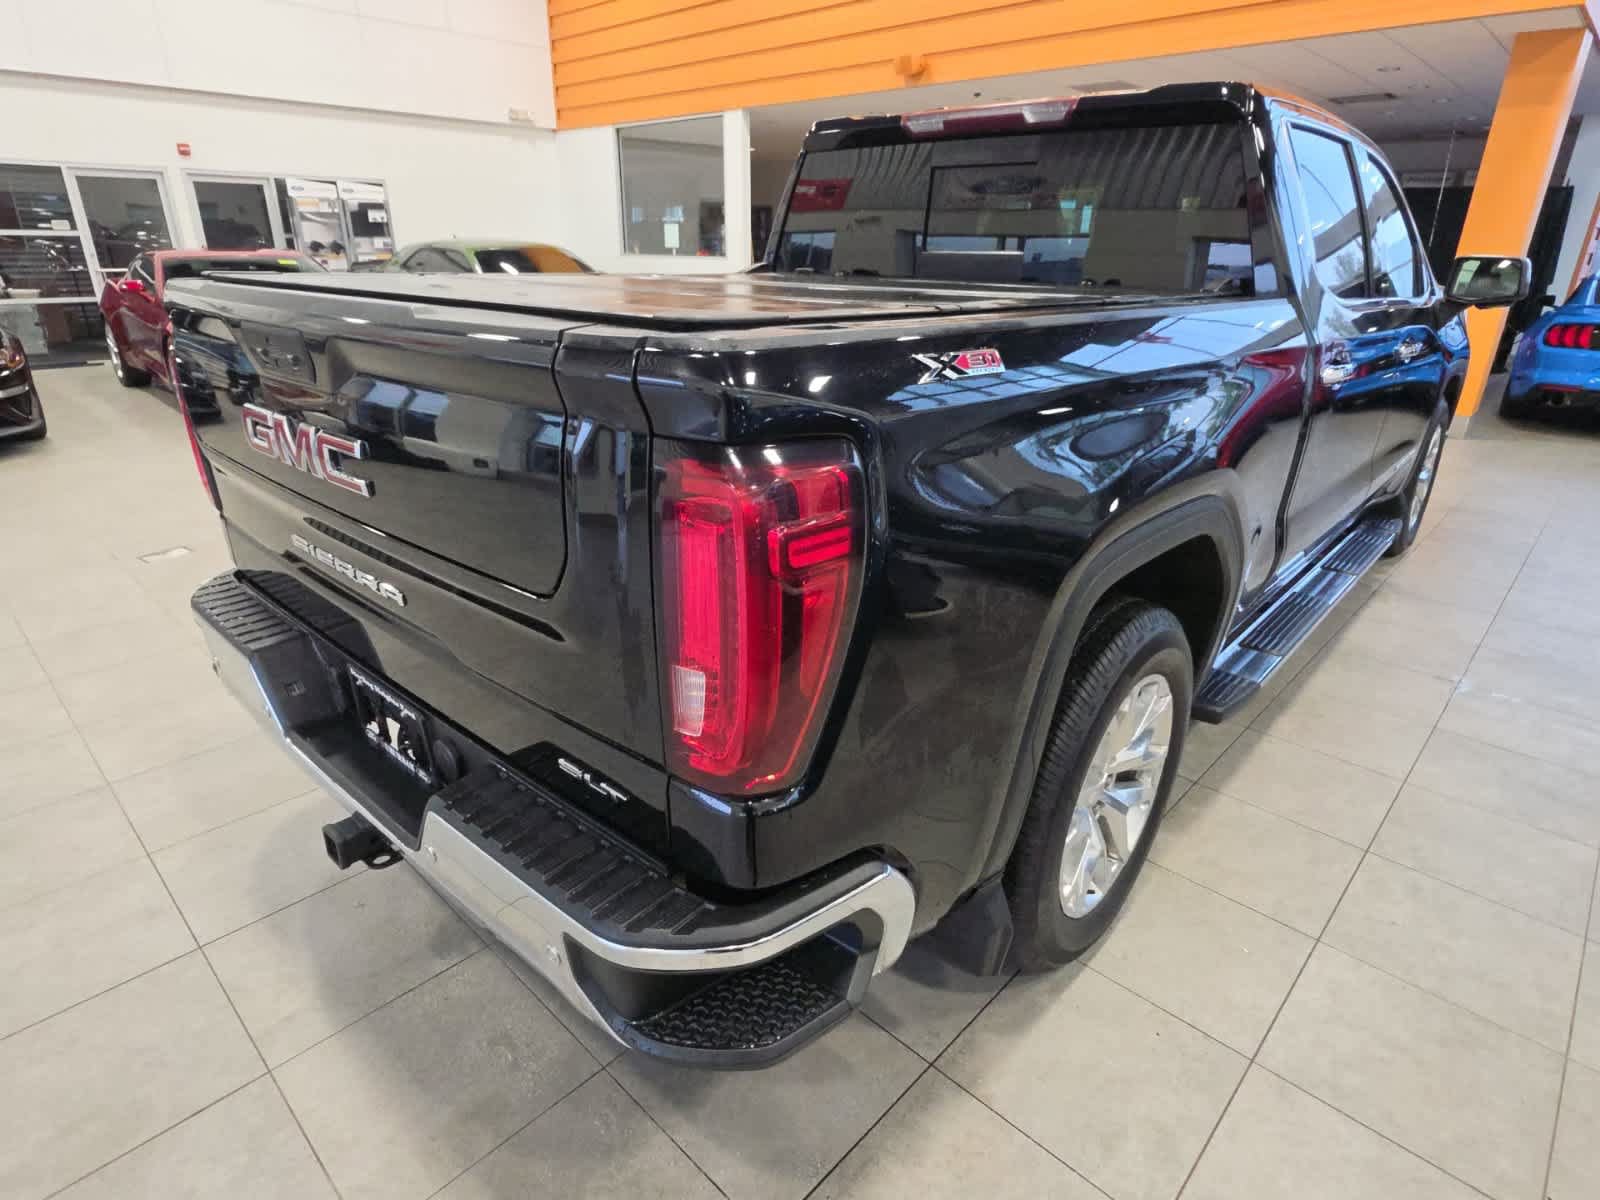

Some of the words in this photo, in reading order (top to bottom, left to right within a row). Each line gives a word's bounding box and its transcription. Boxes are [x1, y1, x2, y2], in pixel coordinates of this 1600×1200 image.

[242, 402, 375, 498] GMC
[290, 534, 407, 607] SIERRA
[558, 758, 627, 802] SLT
